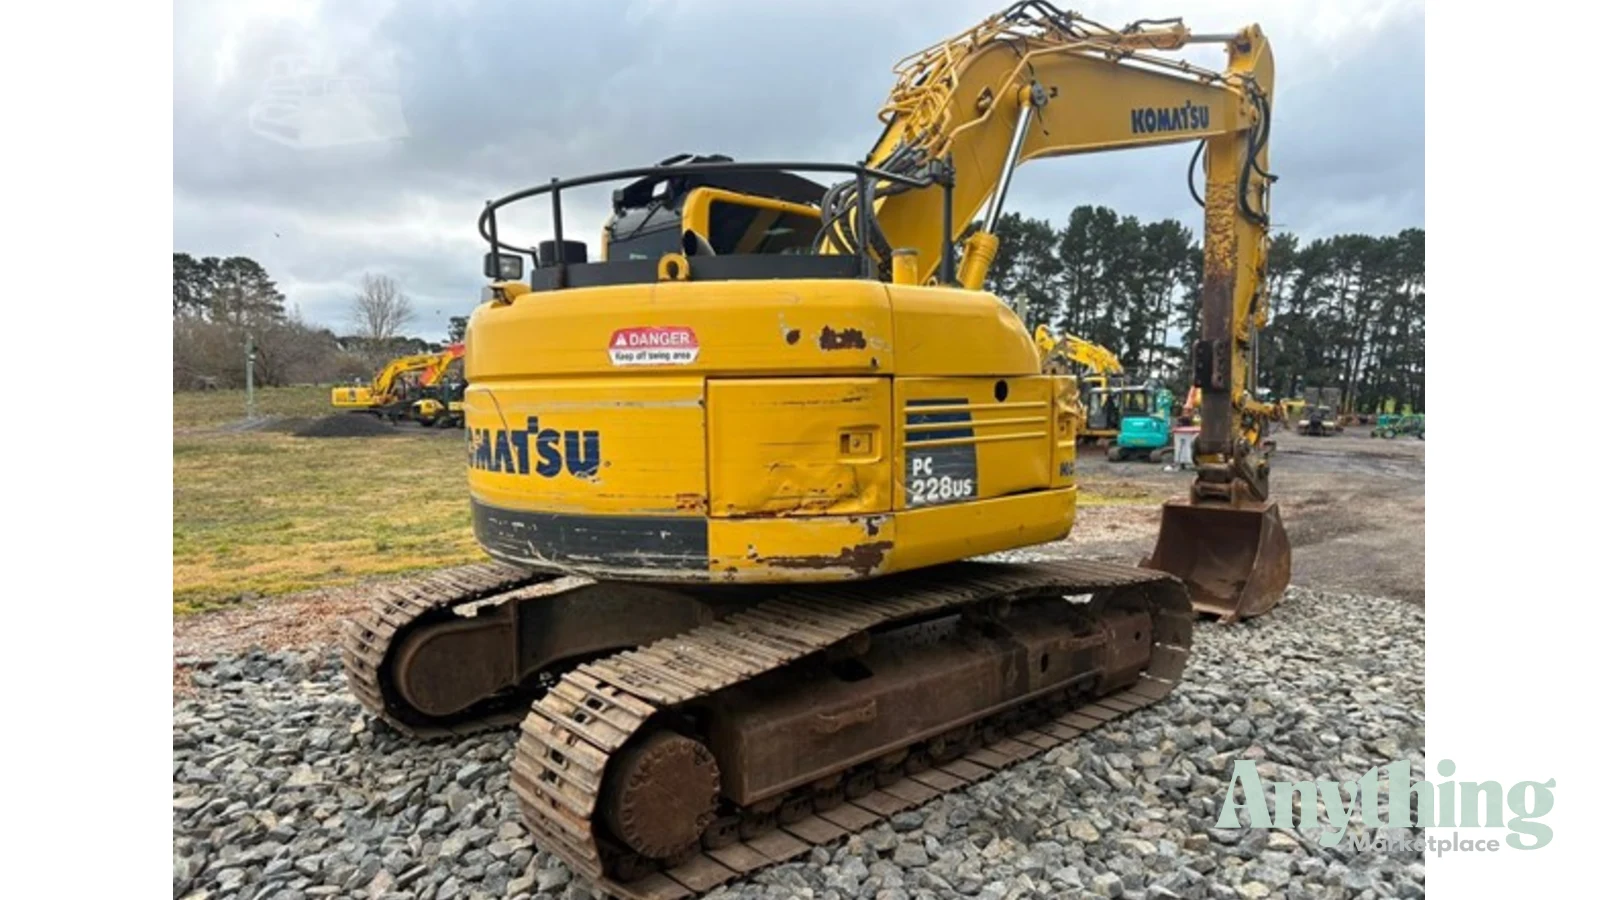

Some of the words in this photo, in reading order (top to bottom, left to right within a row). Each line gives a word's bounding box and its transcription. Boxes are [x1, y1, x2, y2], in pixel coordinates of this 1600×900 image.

[1131, 100, 1209, 133] KOMATSU
[629, 331, 690, 346] DANGER
[615, 351, 634, 361] Keep
[636, 351, 647, 360] off
[648, 352, 671, 361] swing
[673, 352, 692, 360] area
[912, 456, 932, 476] PC
[911, 475, 973, 502] 228US
